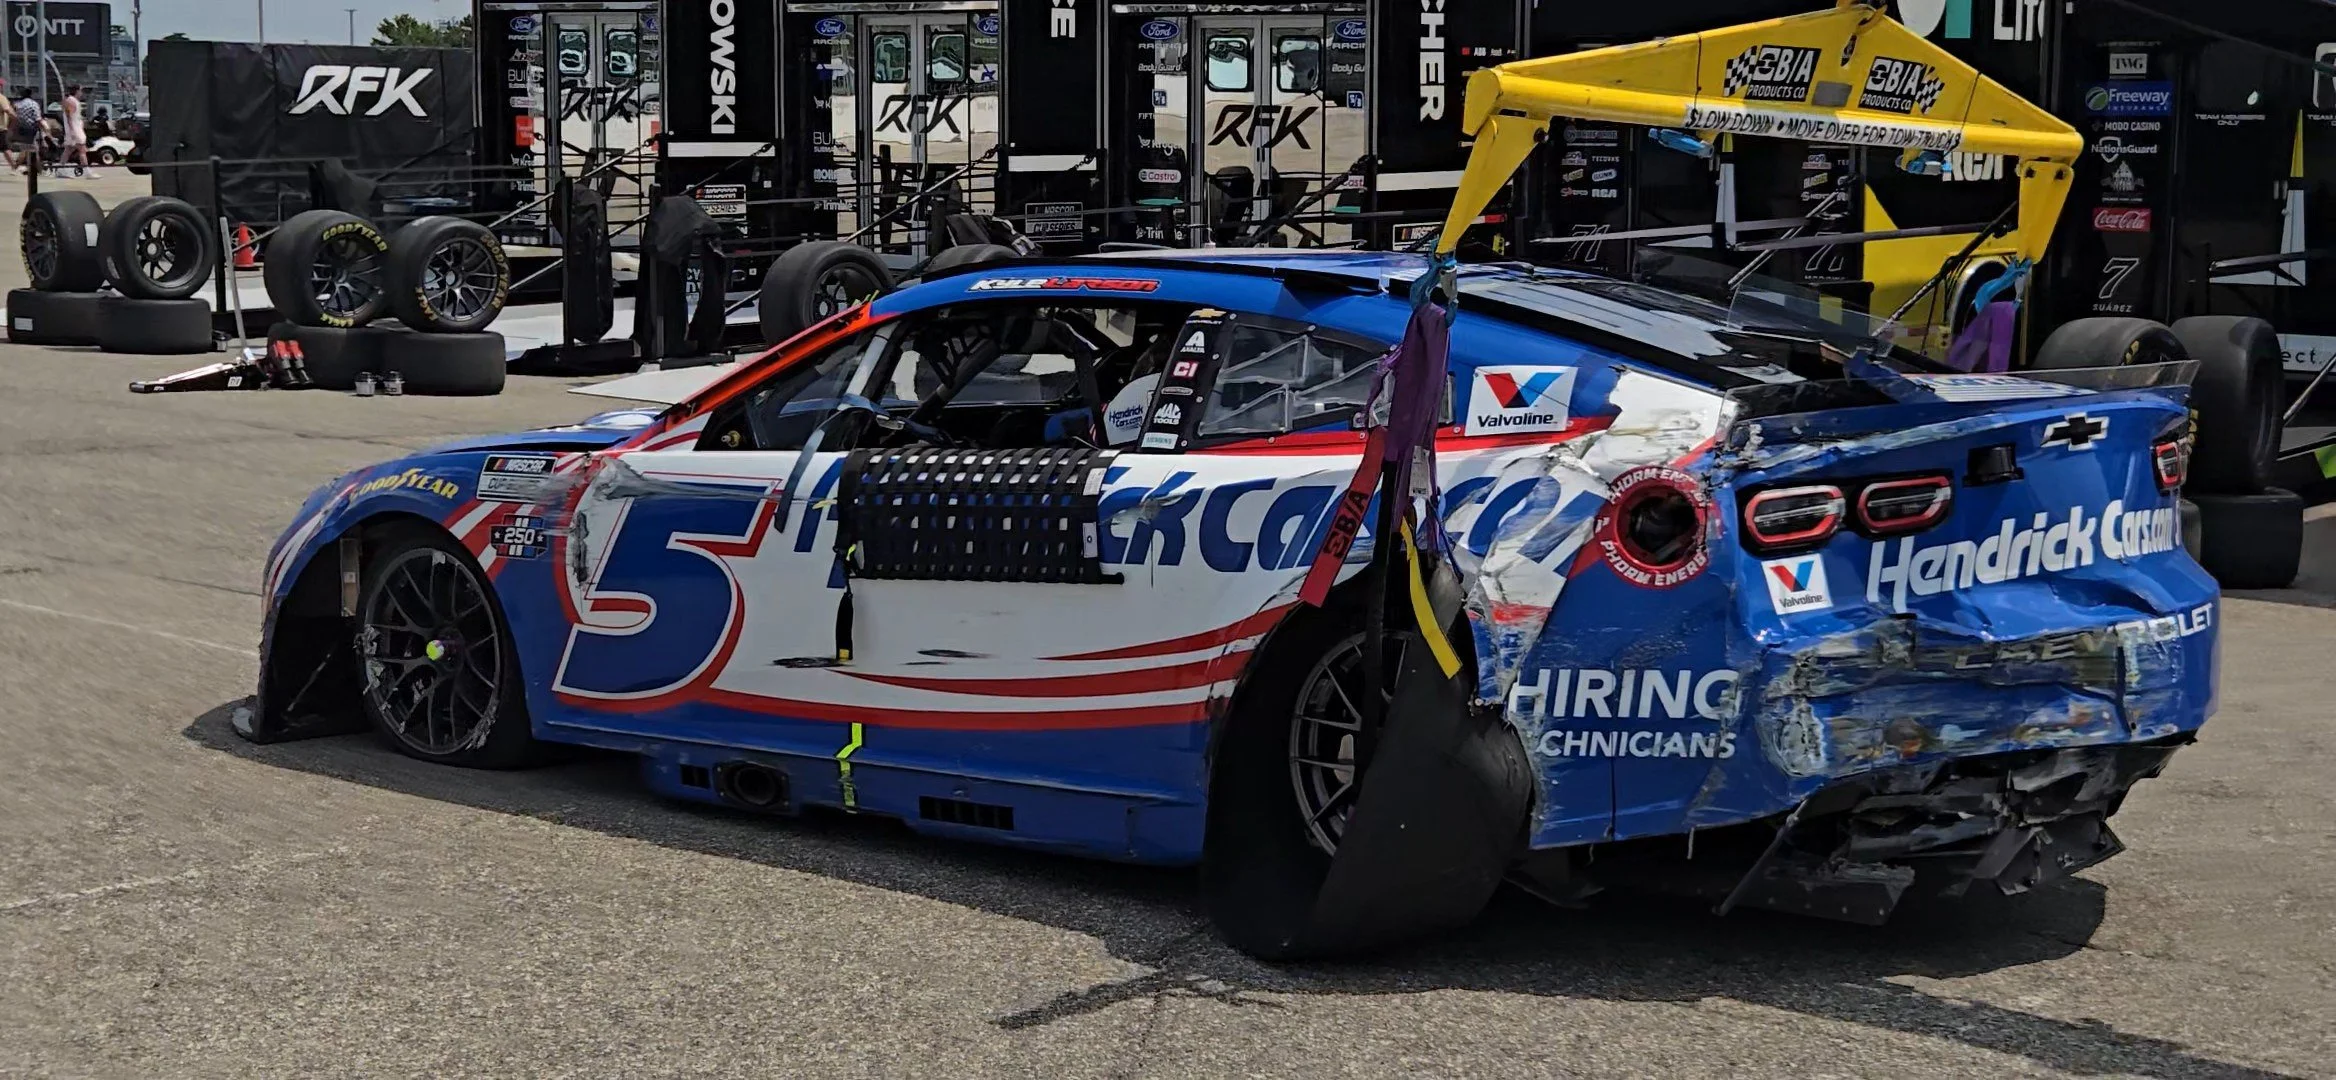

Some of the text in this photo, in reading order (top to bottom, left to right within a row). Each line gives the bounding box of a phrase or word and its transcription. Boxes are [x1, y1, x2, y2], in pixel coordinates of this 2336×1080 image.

[43, 18, 85, 35] NTT
[1051, 0, 1075, 38] E
[710, 0, 735, 134] OWSKI
[1138, 62, 1157, 74] Body
[2112, 57, 2144, 70] TWG
[290, 65, 435, 118] RFK
[1747, 84, 1793, 98] PRODUCTS
[2109, 88, 2170, 106] Freeway
[1860, 93, 1902, 109] PRODUCTS
[1207, 104, 1320, 150] RFK
[1686, 108, 1731, 129] SLOW
[1729, 112, 1775, 133] DOWN
[1787, 117, 1825, 139] MOVE
[1824, 121, 1860, 141] OVER
[1860, 124, 1889, 144] FOR
[2131, 122, 2161, 131] CASINO
[2091, 144, 2158, 154] NationsGuard
[1591, 188, 1618, 198] RCA
[323, 222, 389, 252] GOODYEAR
[2098, 257, 2139, 299] 7
[2092, 302, 2133, 313] SUÁREZ
[1173, 361, 1199, 377] CI
[1477, 412, 1554, 428] Valvoline
[504, 459, 546, 473] NASCAR
[503, 527, 535, 545] 250
[1600, 540, 1652, 585] PHORM
[551, 472, 783, 701] 5
[1778, 592, 1823, 608] Valvoline
[1536, 729, 1737, 758] CHNICIANS
